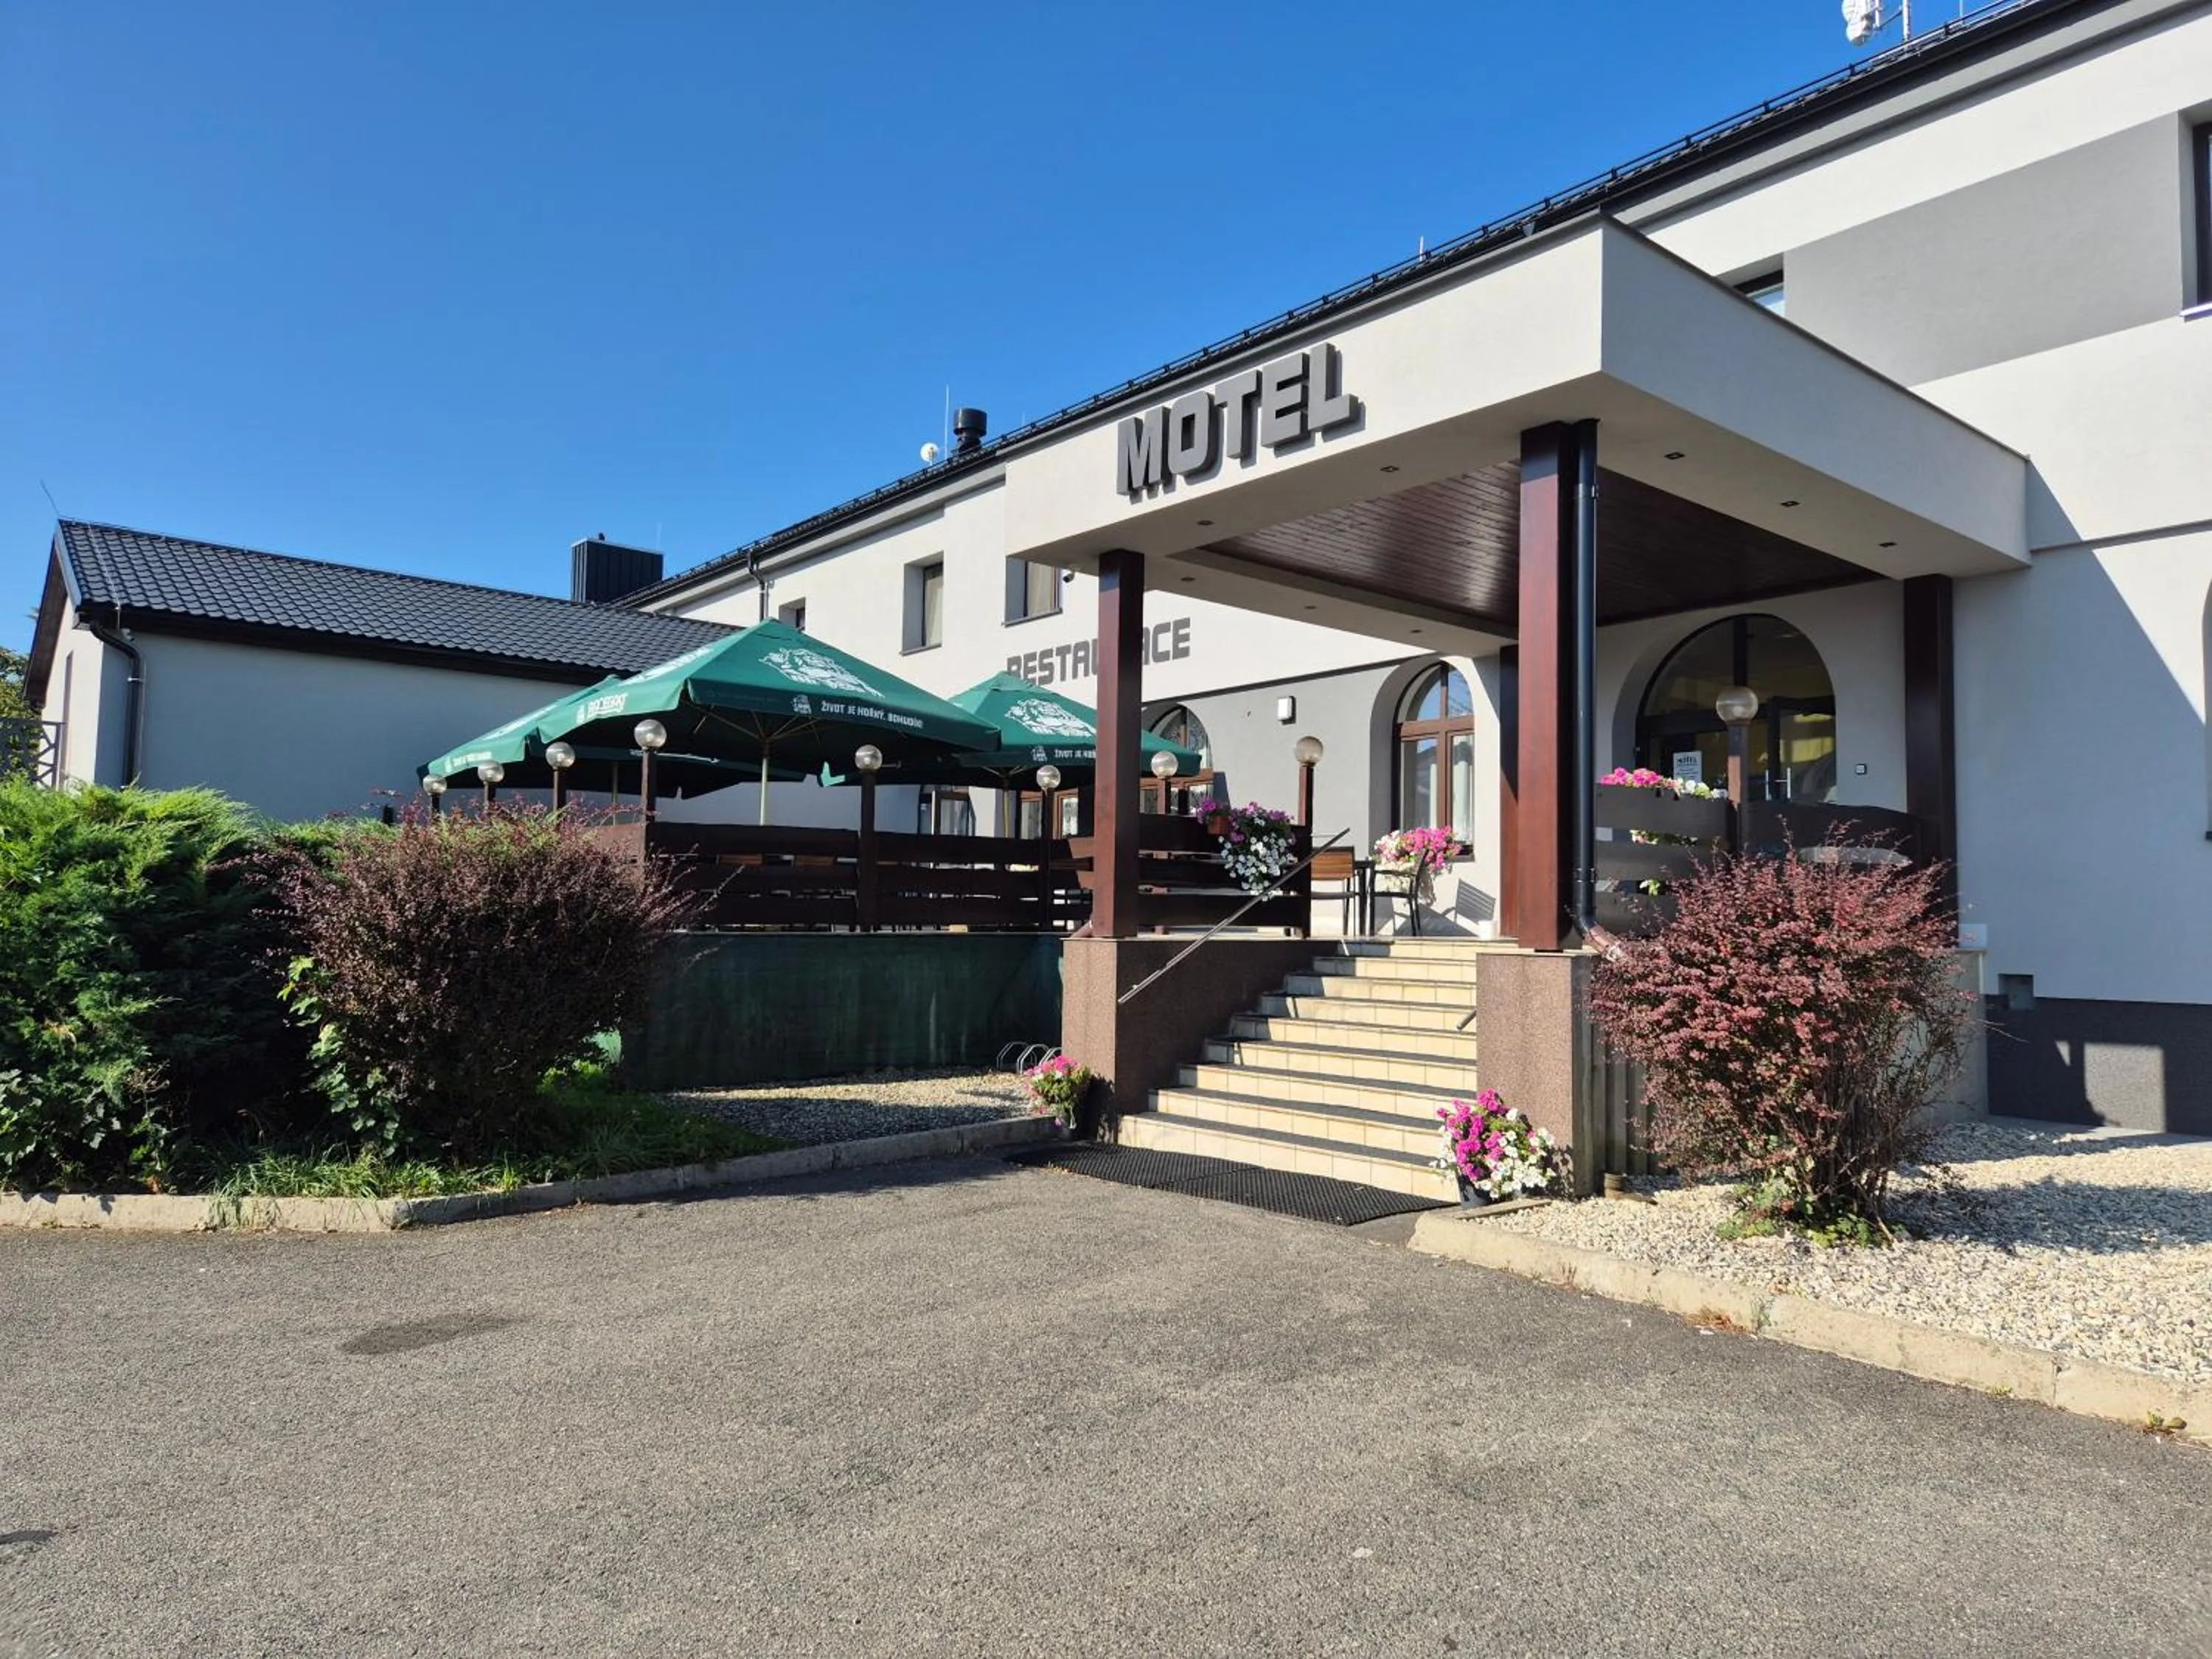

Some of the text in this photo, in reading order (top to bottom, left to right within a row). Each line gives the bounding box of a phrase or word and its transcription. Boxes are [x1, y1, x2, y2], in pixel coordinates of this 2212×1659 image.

[1116, 342, 1358, 495] MOTEL
[1007, 618, 1191, 686] RESTACE
[821, 700, 846, 713] ŽIVOT
[847, 706, 856, 714] JE
